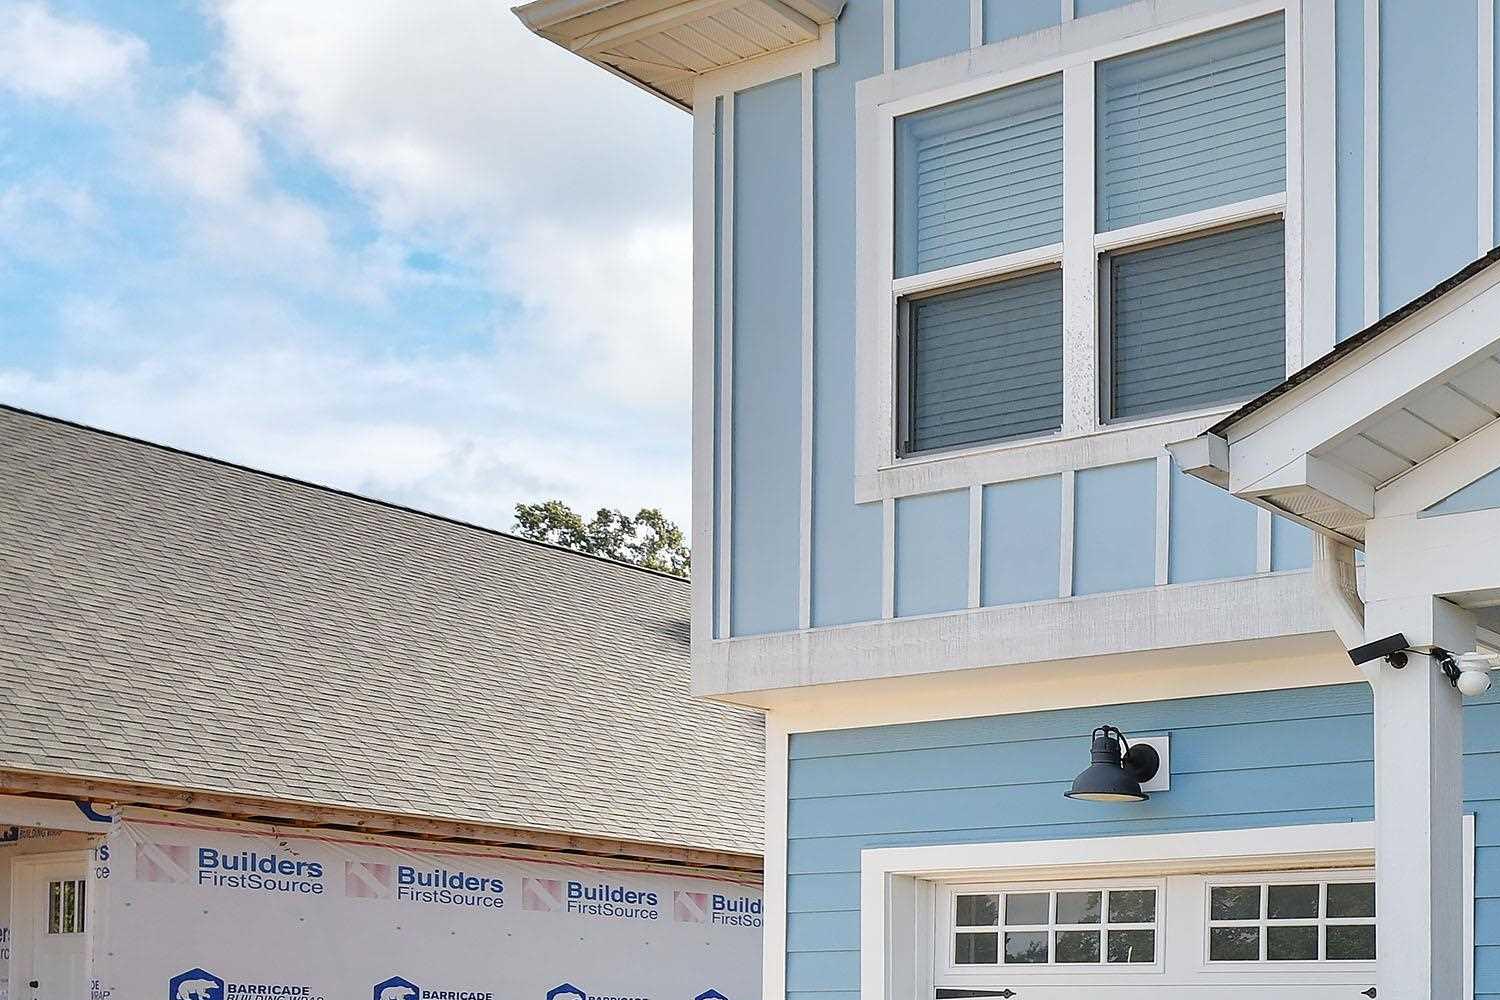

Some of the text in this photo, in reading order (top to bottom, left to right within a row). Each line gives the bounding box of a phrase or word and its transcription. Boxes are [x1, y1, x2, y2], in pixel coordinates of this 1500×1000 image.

[198, 847, 323, 878] Builders
[198, 870, 324, 894] FirstSource
[397, 865, 504, 893] Builders
[397, 886, 504, 908] FirstSource
[567, 881, 658, 906] Builders
[712, 894, 764, 915] Build
[567, 900, 659, 920] FirstSource
[712, 912, 764, 928] FirstSo
[227, 983, 310, 996] BARRICADE
